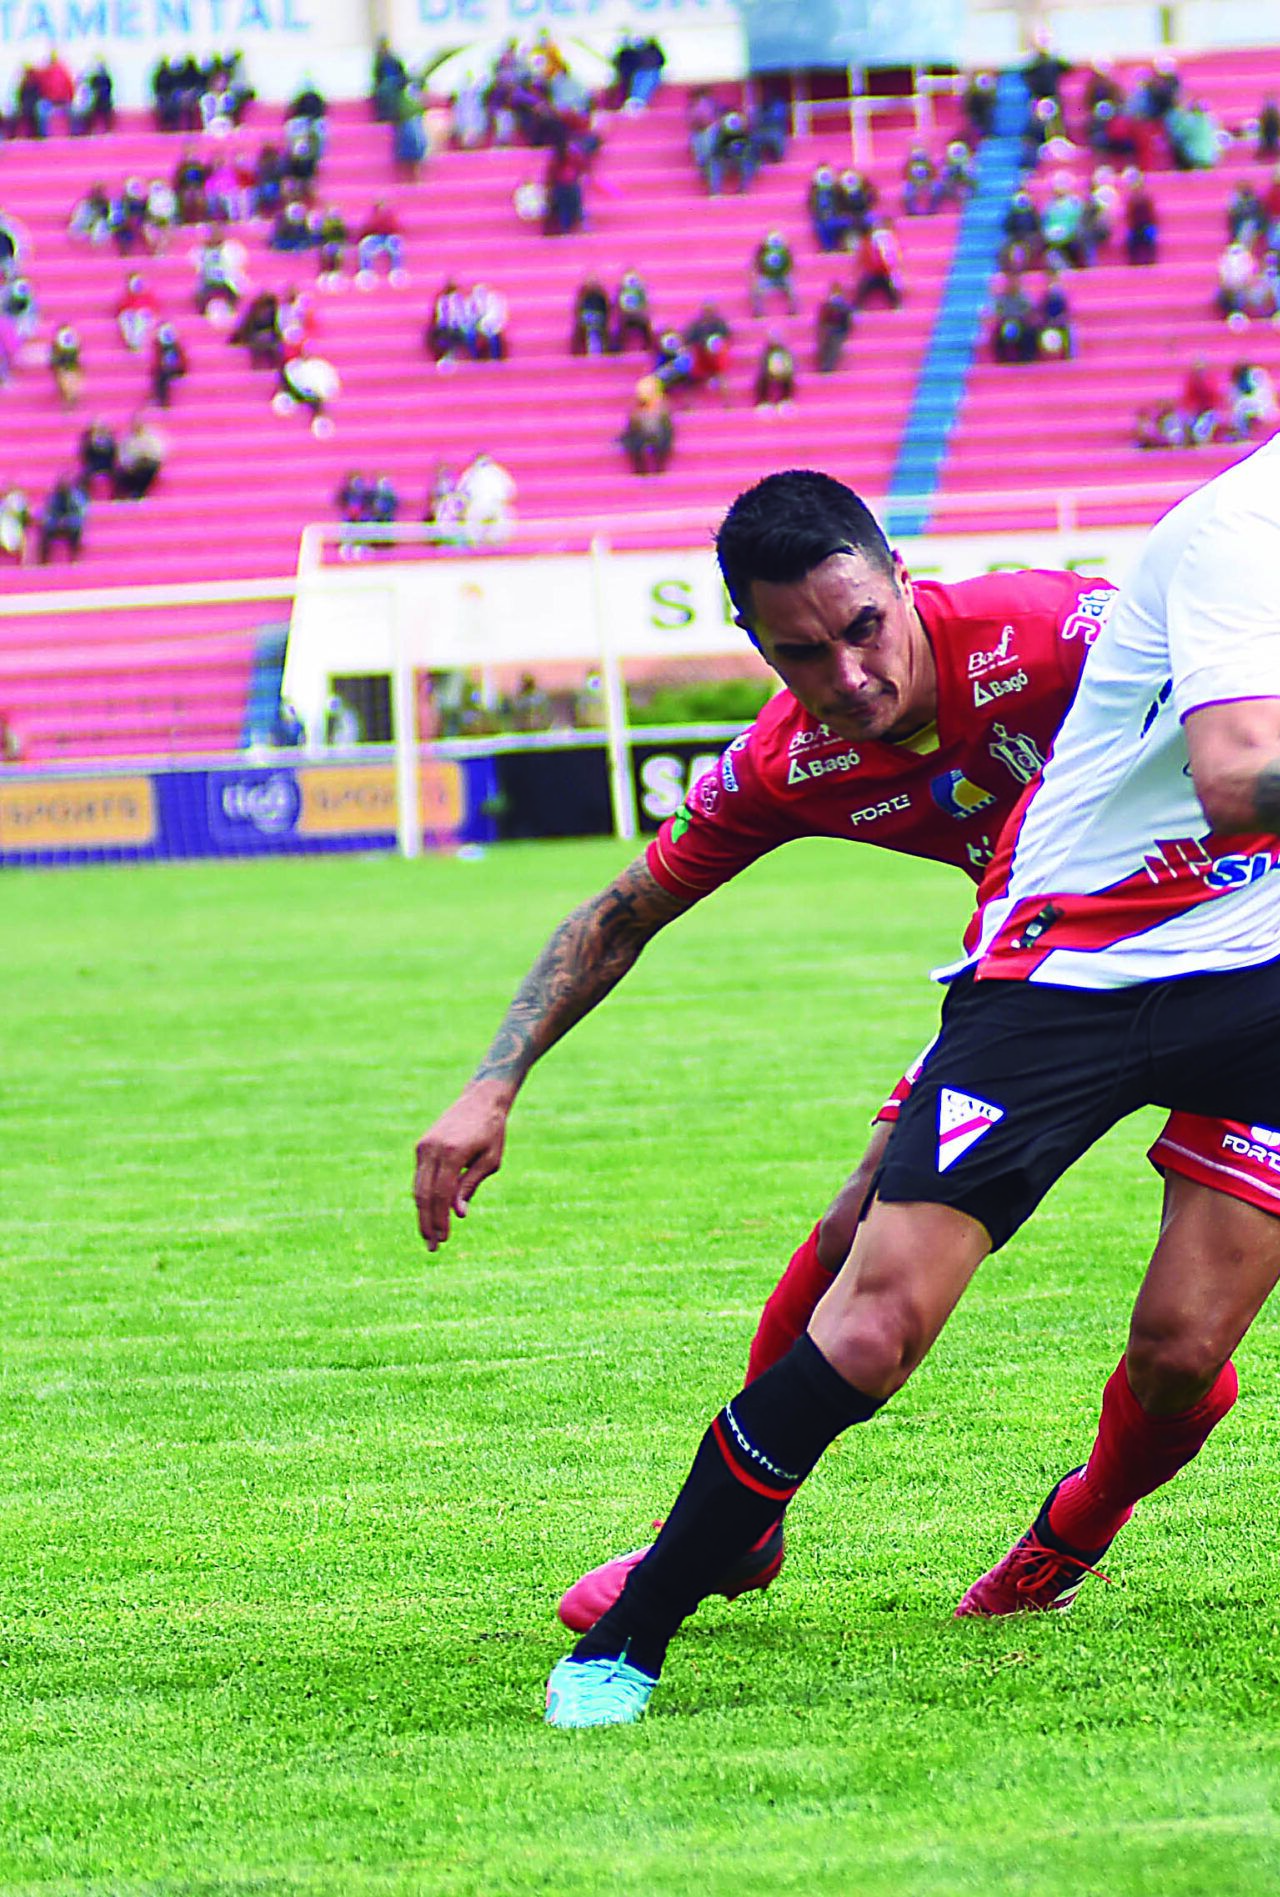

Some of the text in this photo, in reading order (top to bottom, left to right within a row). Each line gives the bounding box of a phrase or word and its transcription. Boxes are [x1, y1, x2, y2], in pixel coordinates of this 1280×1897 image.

[988, 668, 1029, 698] Bagó
[807, 748, 861, 777] Bagó
[850, 794, 912, 826] FORTE
